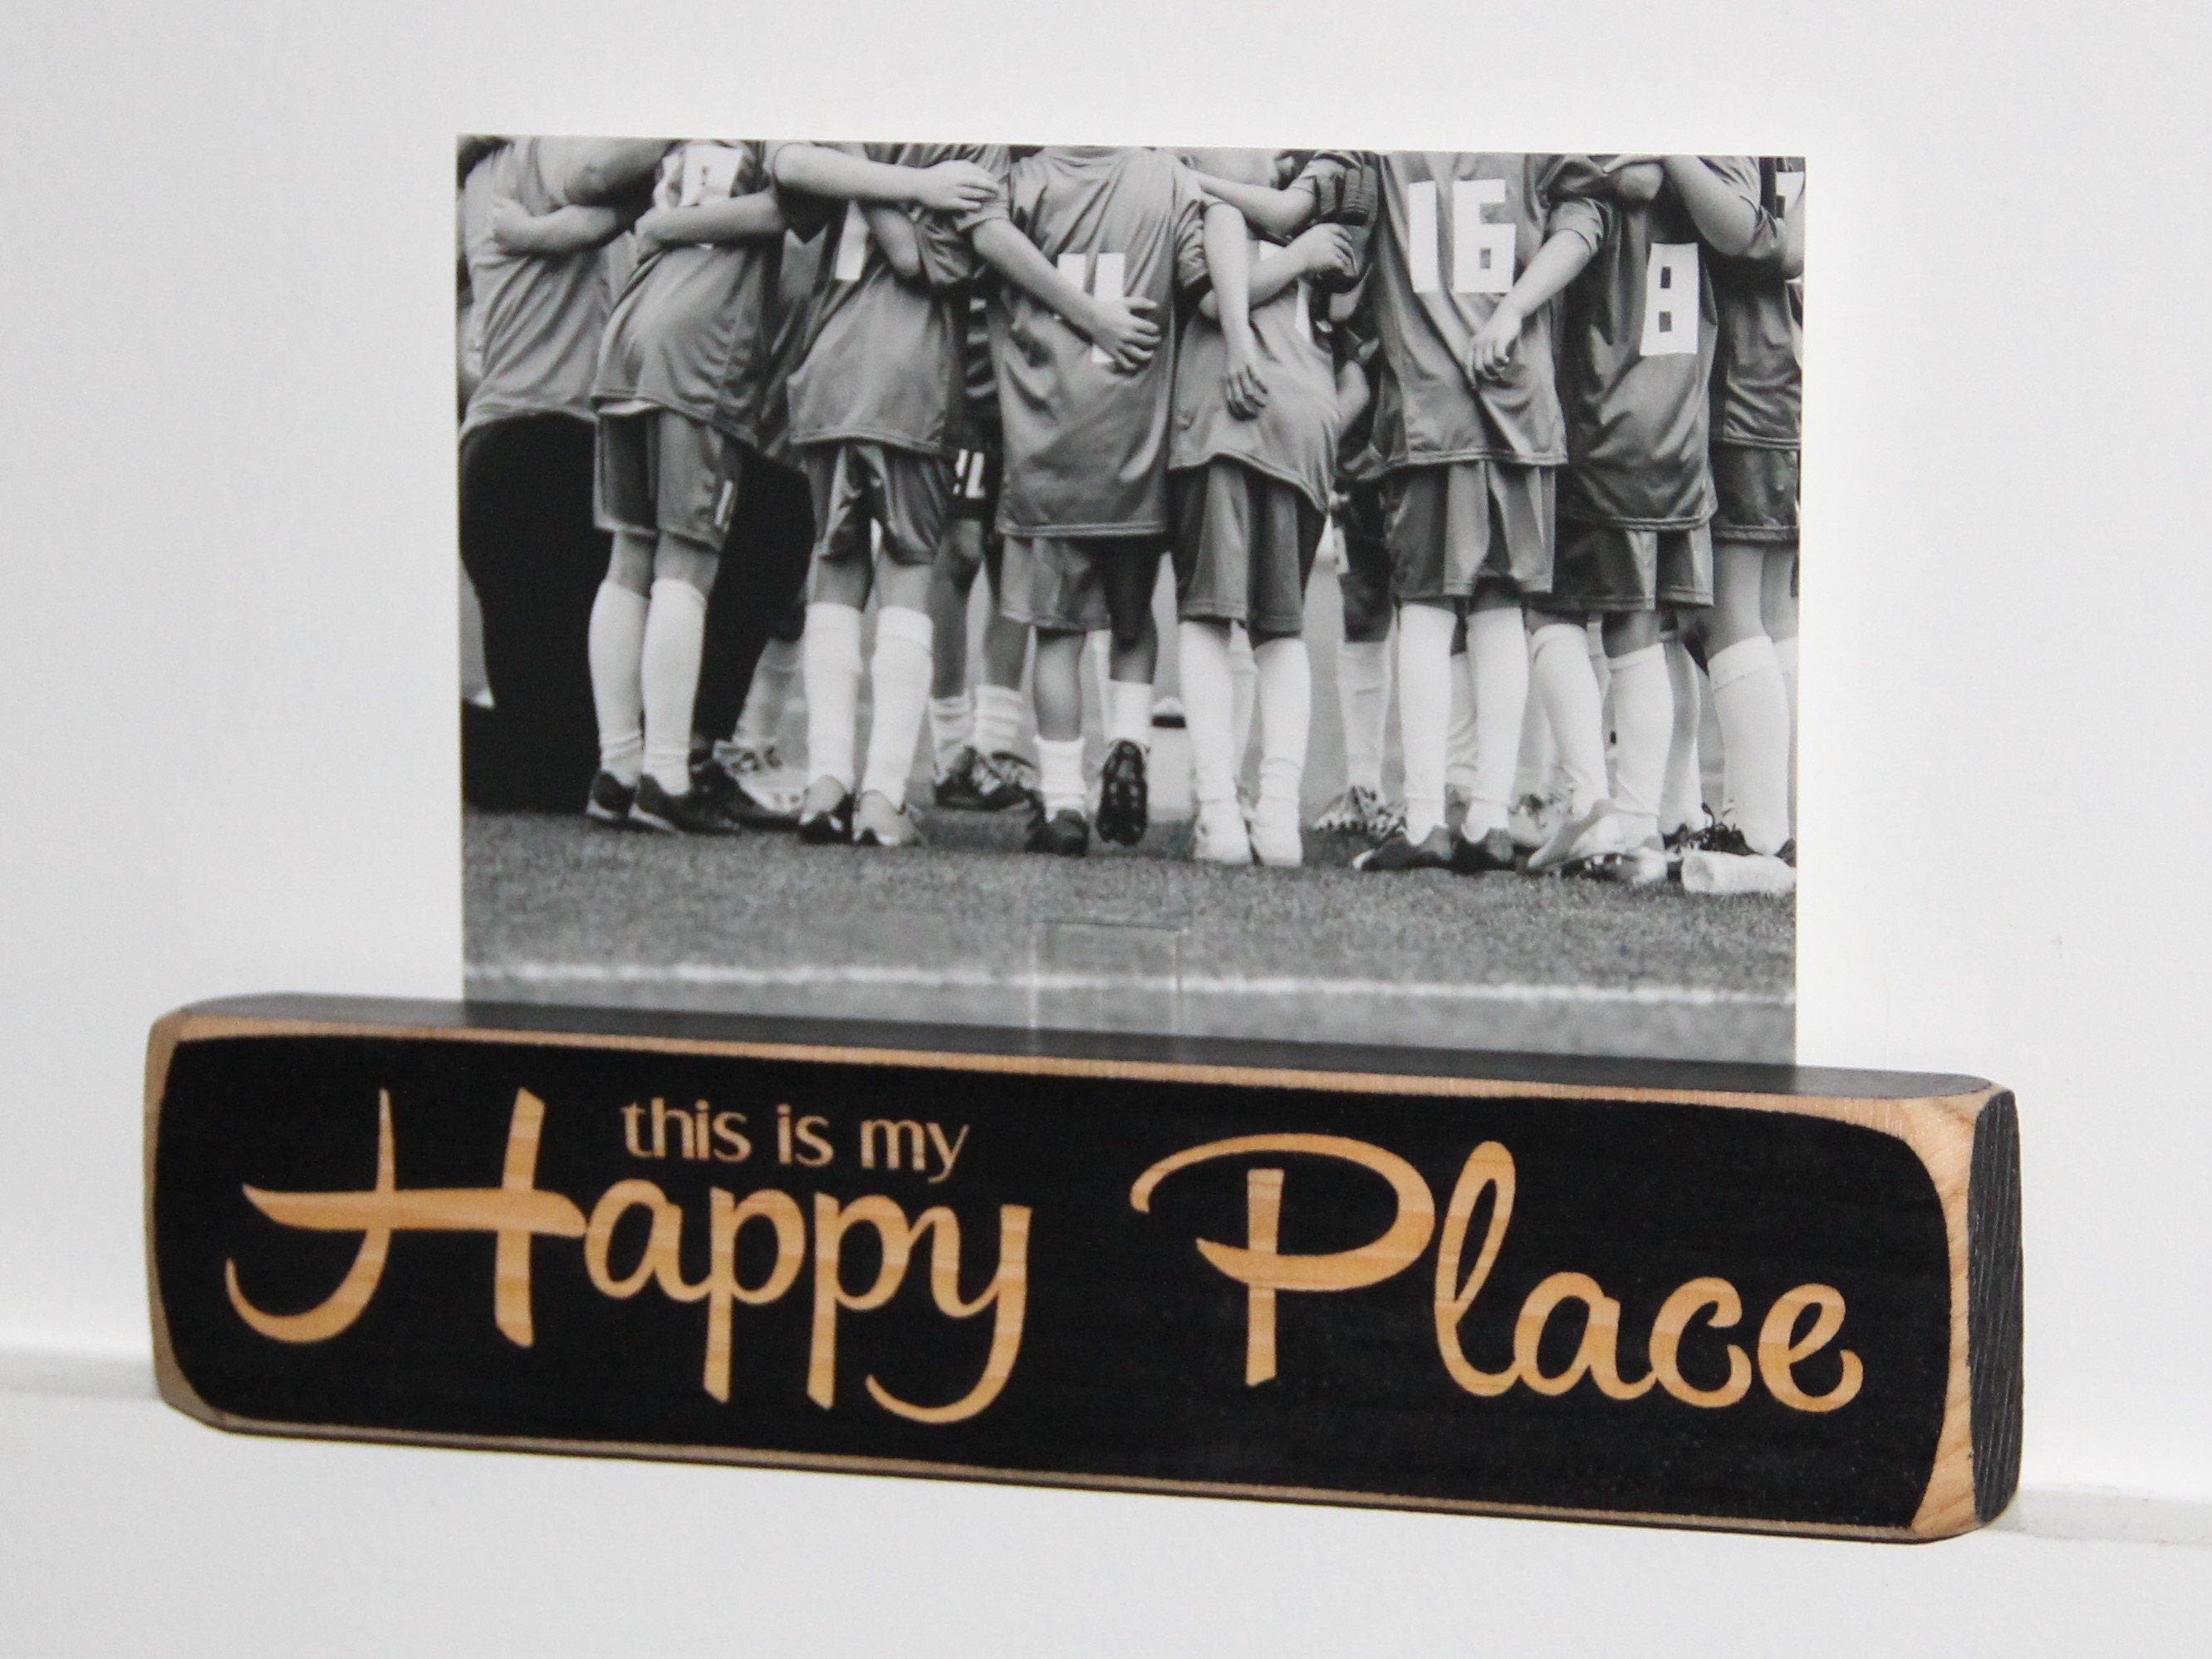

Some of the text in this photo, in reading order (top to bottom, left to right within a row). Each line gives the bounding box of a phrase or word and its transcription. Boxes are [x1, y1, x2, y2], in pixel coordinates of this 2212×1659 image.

[1407, 179, 1516, 294] 16
[1640, 243, 1699, 356] 8
[621, 1097, 970, 1184] this is my
[225, 1087, 1864, 1424] Happy Place
